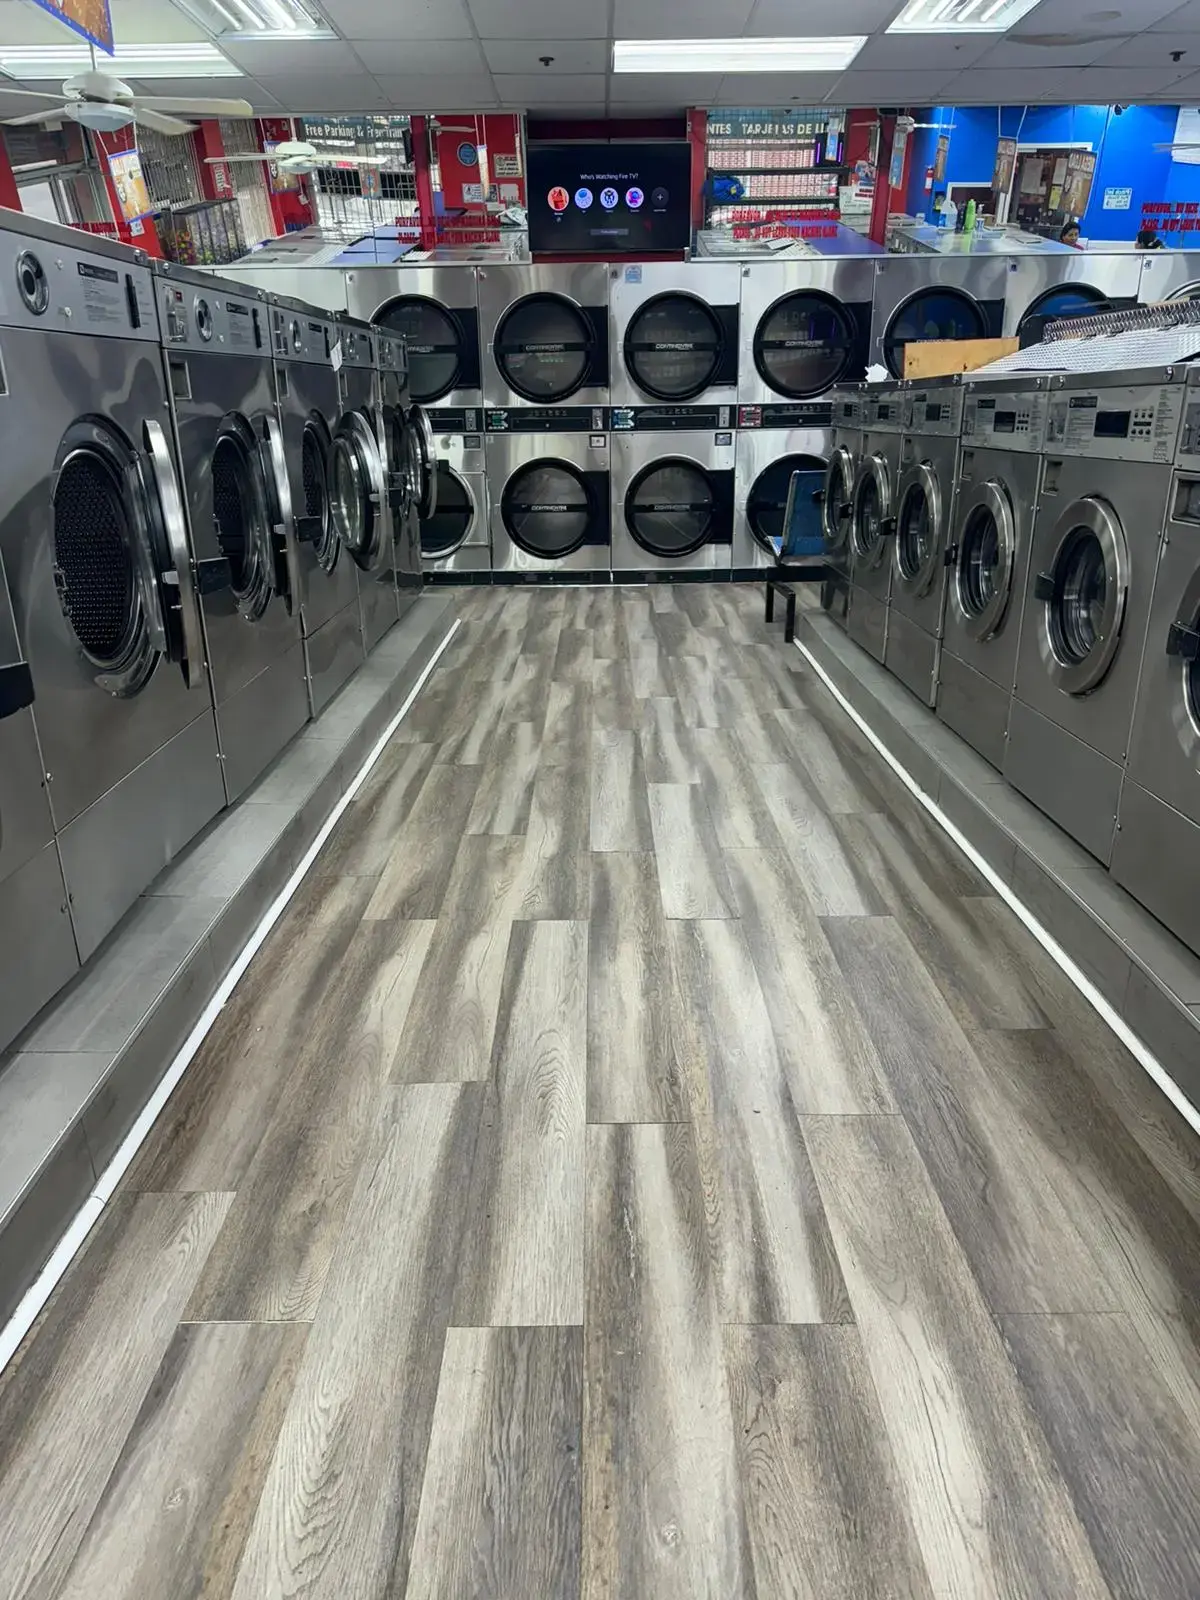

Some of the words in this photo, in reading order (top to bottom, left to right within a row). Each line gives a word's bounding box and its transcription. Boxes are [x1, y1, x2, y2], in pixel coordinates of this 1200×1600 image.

[304, 124, 323, 136] Free
[324, 124, 356, 138] Parking
[797, 123, 812, 135] DE
[595, 173, 618, 181] Watching
